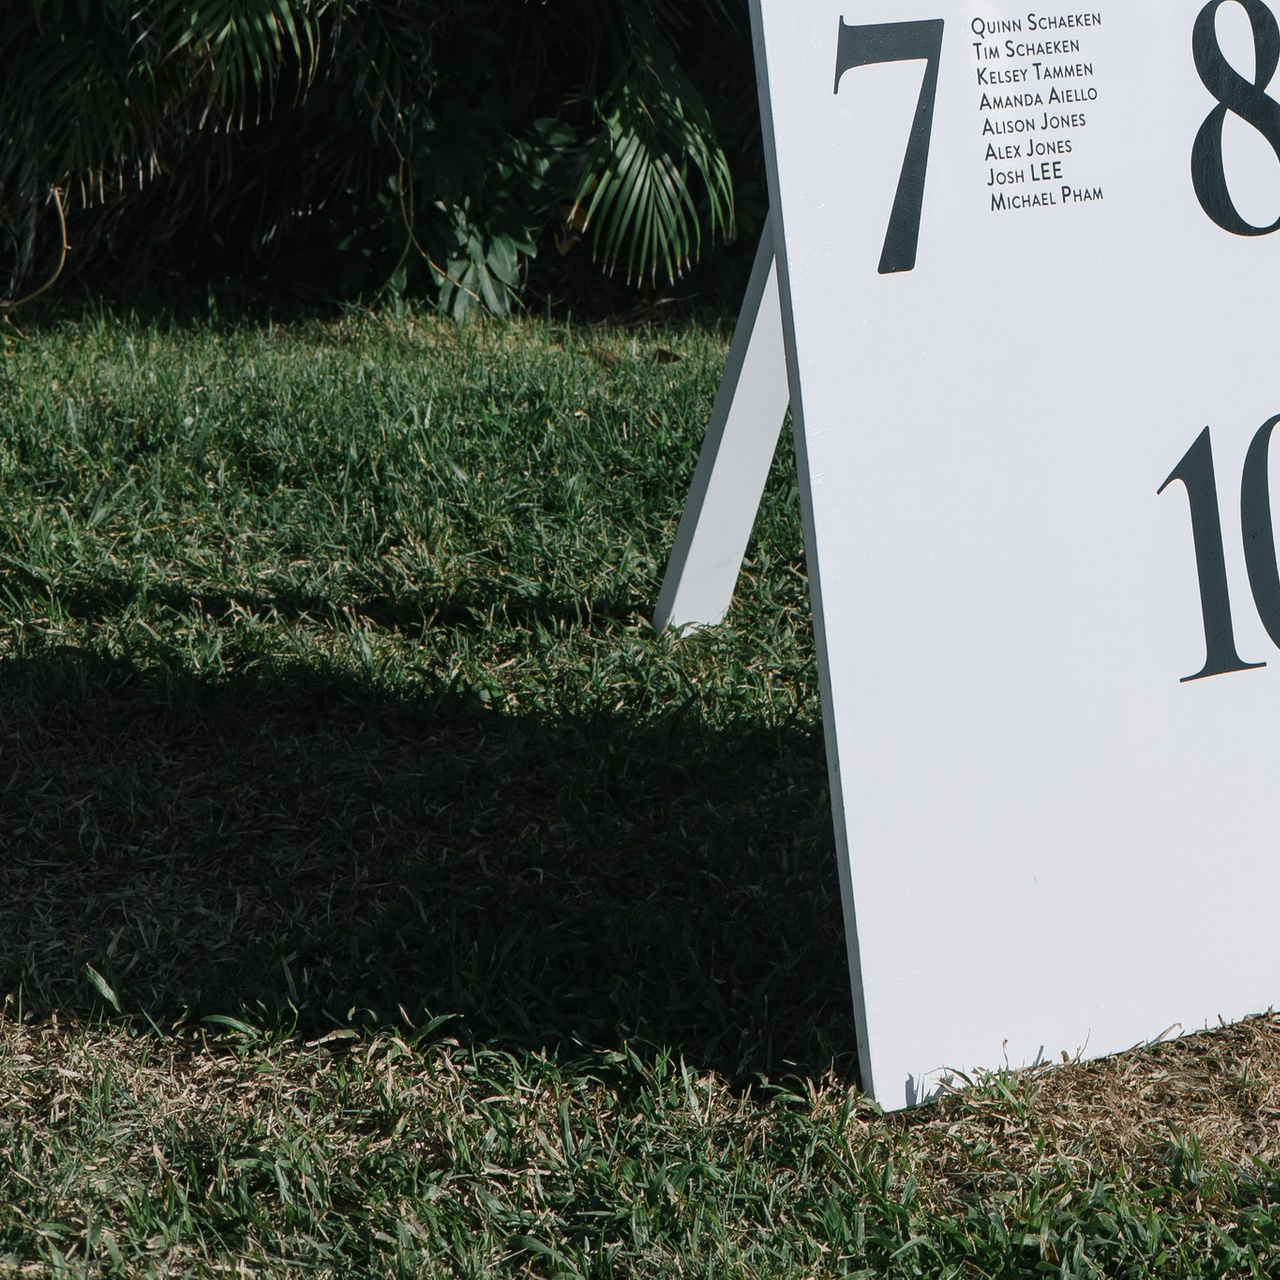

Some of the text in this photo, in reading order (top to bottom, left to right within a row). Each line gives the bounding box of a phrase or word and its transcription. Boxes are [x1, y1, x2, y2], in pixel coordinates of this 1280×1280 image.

[971, 13, 1101, 38] QUINN SCHAEKEN
[977, 62, 1093, 86] KELSEY TAMMEN
[979, 86, 1097, 111] AMANDA AIELLO
[833, 15, 945, 274] 7
[985, 139, 1072, 161] ALEX JONES
[987, 161, 1063, 186] JOSH LEE
[991, 185, 1103, 211] MICHAEL PHAM
